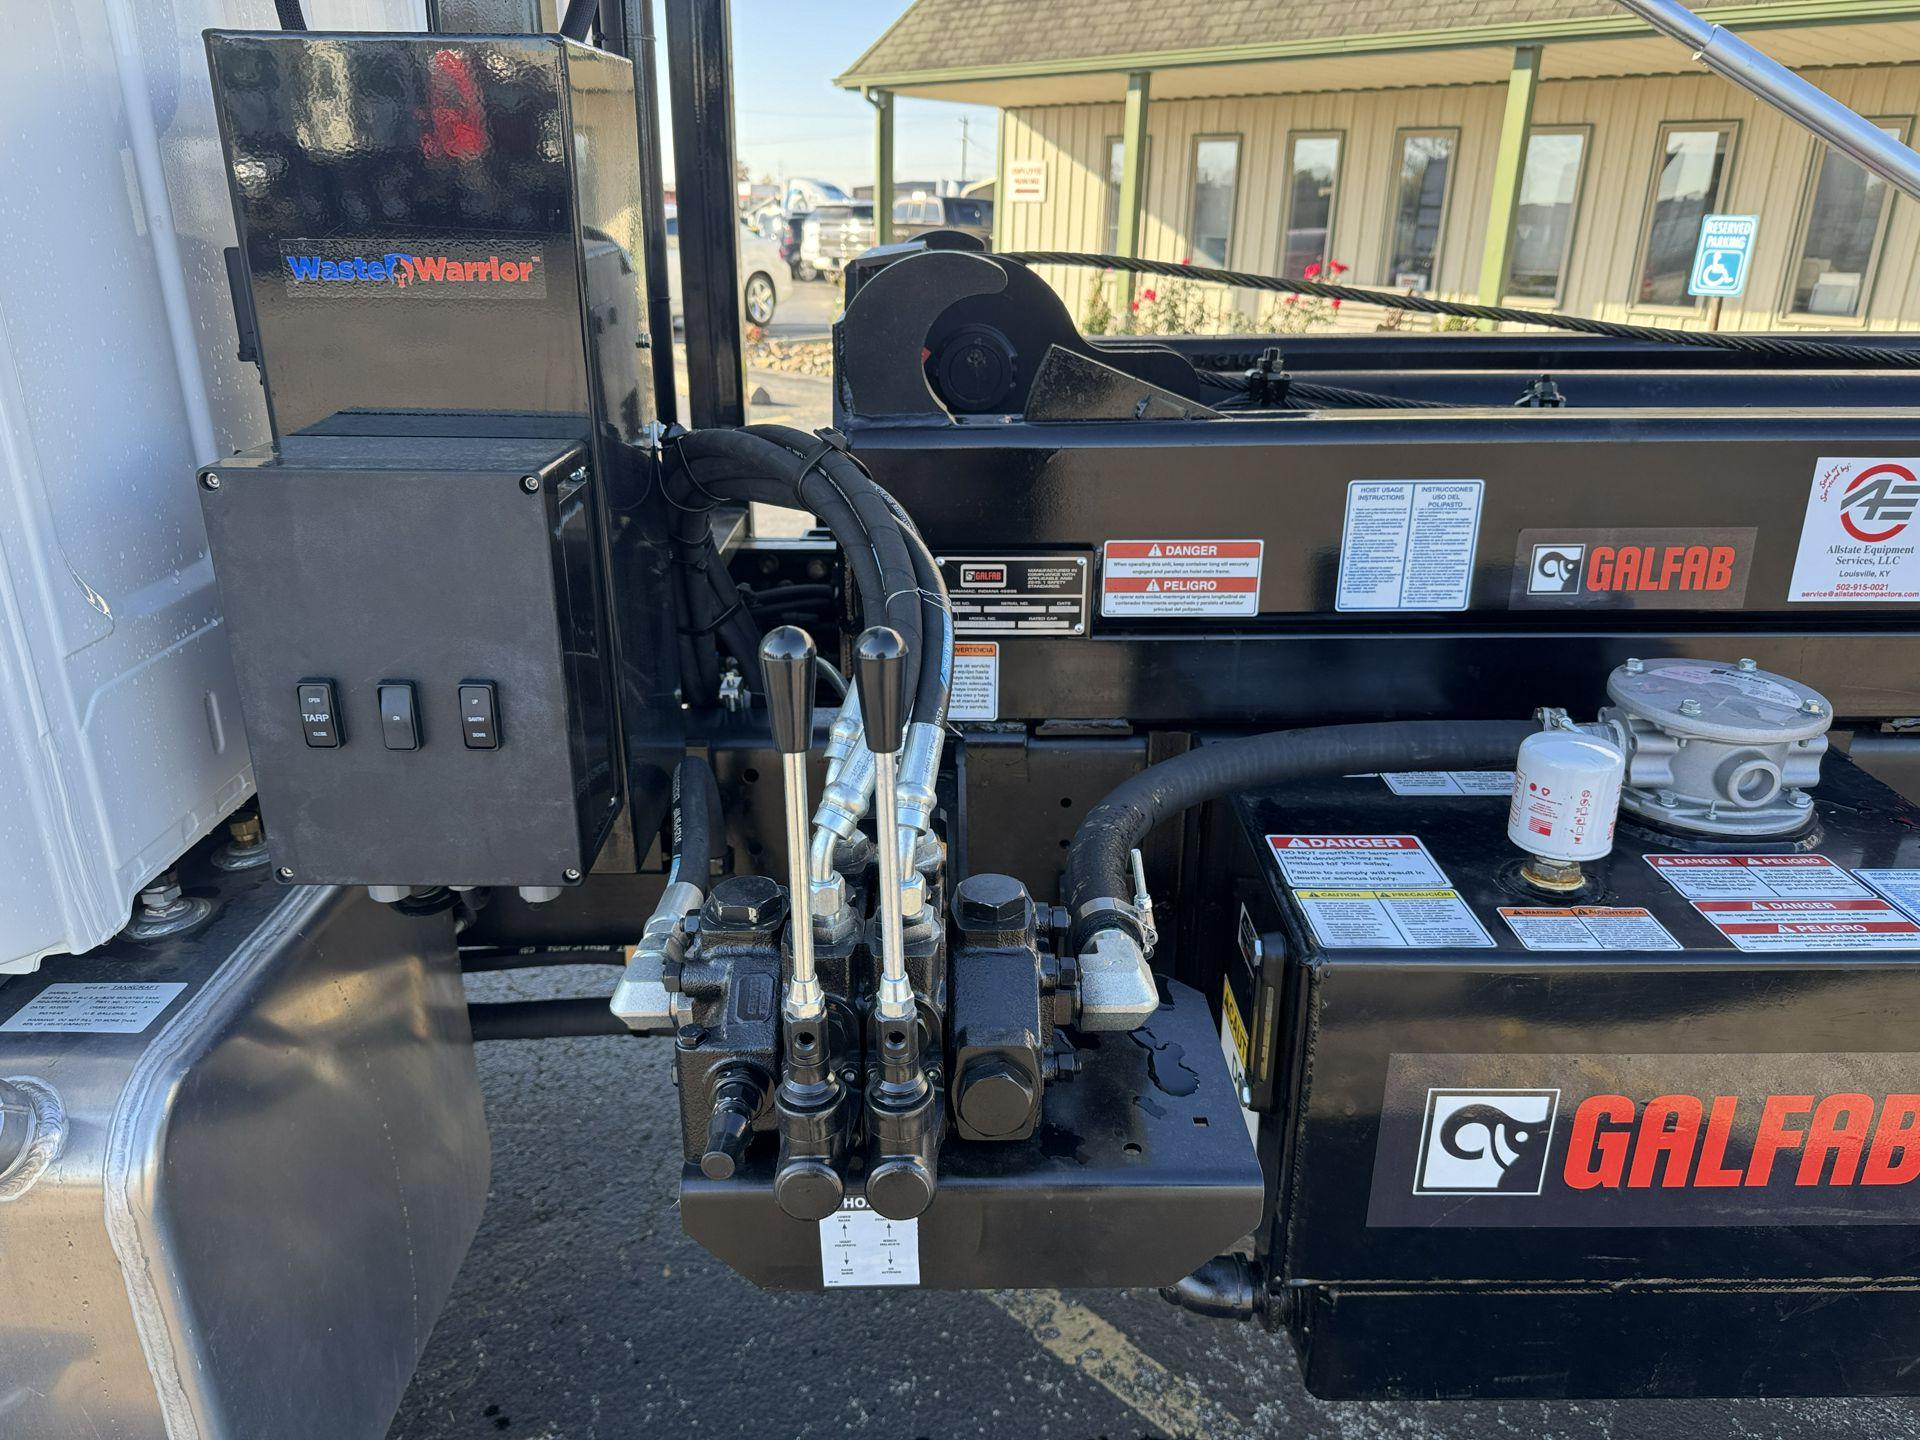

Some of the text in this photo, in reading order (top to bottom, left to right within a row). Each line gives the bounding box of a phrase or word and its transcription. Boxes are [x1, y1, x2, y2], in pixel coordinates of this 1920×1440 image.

[1706, 221, 1752, 234] RESERVED
[1706, 235, 1746, 249] PARKING
[286, 256, 533, 282] Waste Warrior
[1166, 546, 1218, 556] DANGER
[1826, 545, 1914, 555] Allstate Equipment
[1835, 556, 1900, 566] Services, LLC
[1586, 546, 1736, 592] GALFAB
[975, 572, 1002, 580] GALFAB
[1164, 580, 1217, 591] PELIGRO
[934, 706, 944, 726] 4250
[1308, 839, 1403, 847] DANGER
[1562, 1093, 1920, 1190] GALFAB
[843, 1197, 871, 1208] HO
